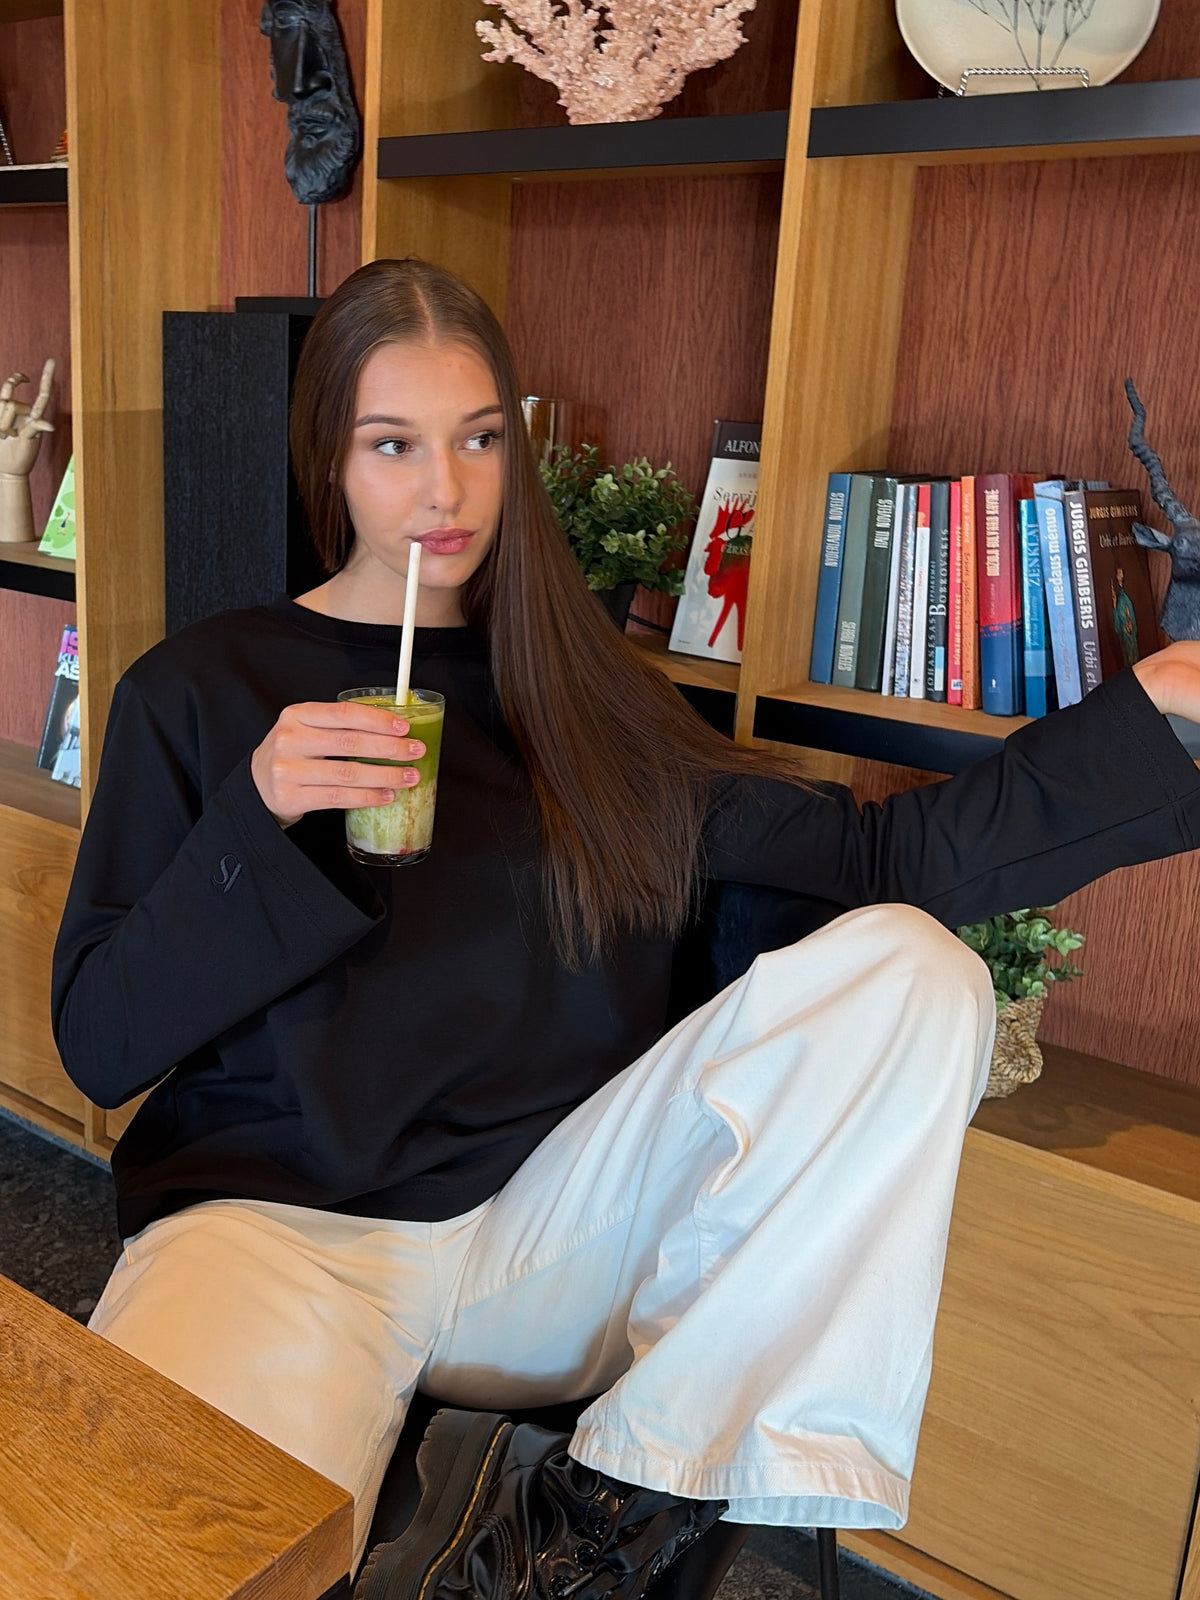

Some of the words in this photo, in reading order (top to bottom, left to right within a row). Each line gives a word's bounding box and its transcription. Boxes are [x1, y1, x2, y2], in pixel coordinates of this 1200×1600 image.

[1070, 501, 1088, 554] JURGIS
[1048, 552, 1066, 607] medaus
[1075, 556, 1094, 630] GIMBERIS
[926, 616, 936, 692] JOHANESAS
[1082, 640, 1098, 668] Urbi
[1086, 671, 1097, 684] et
